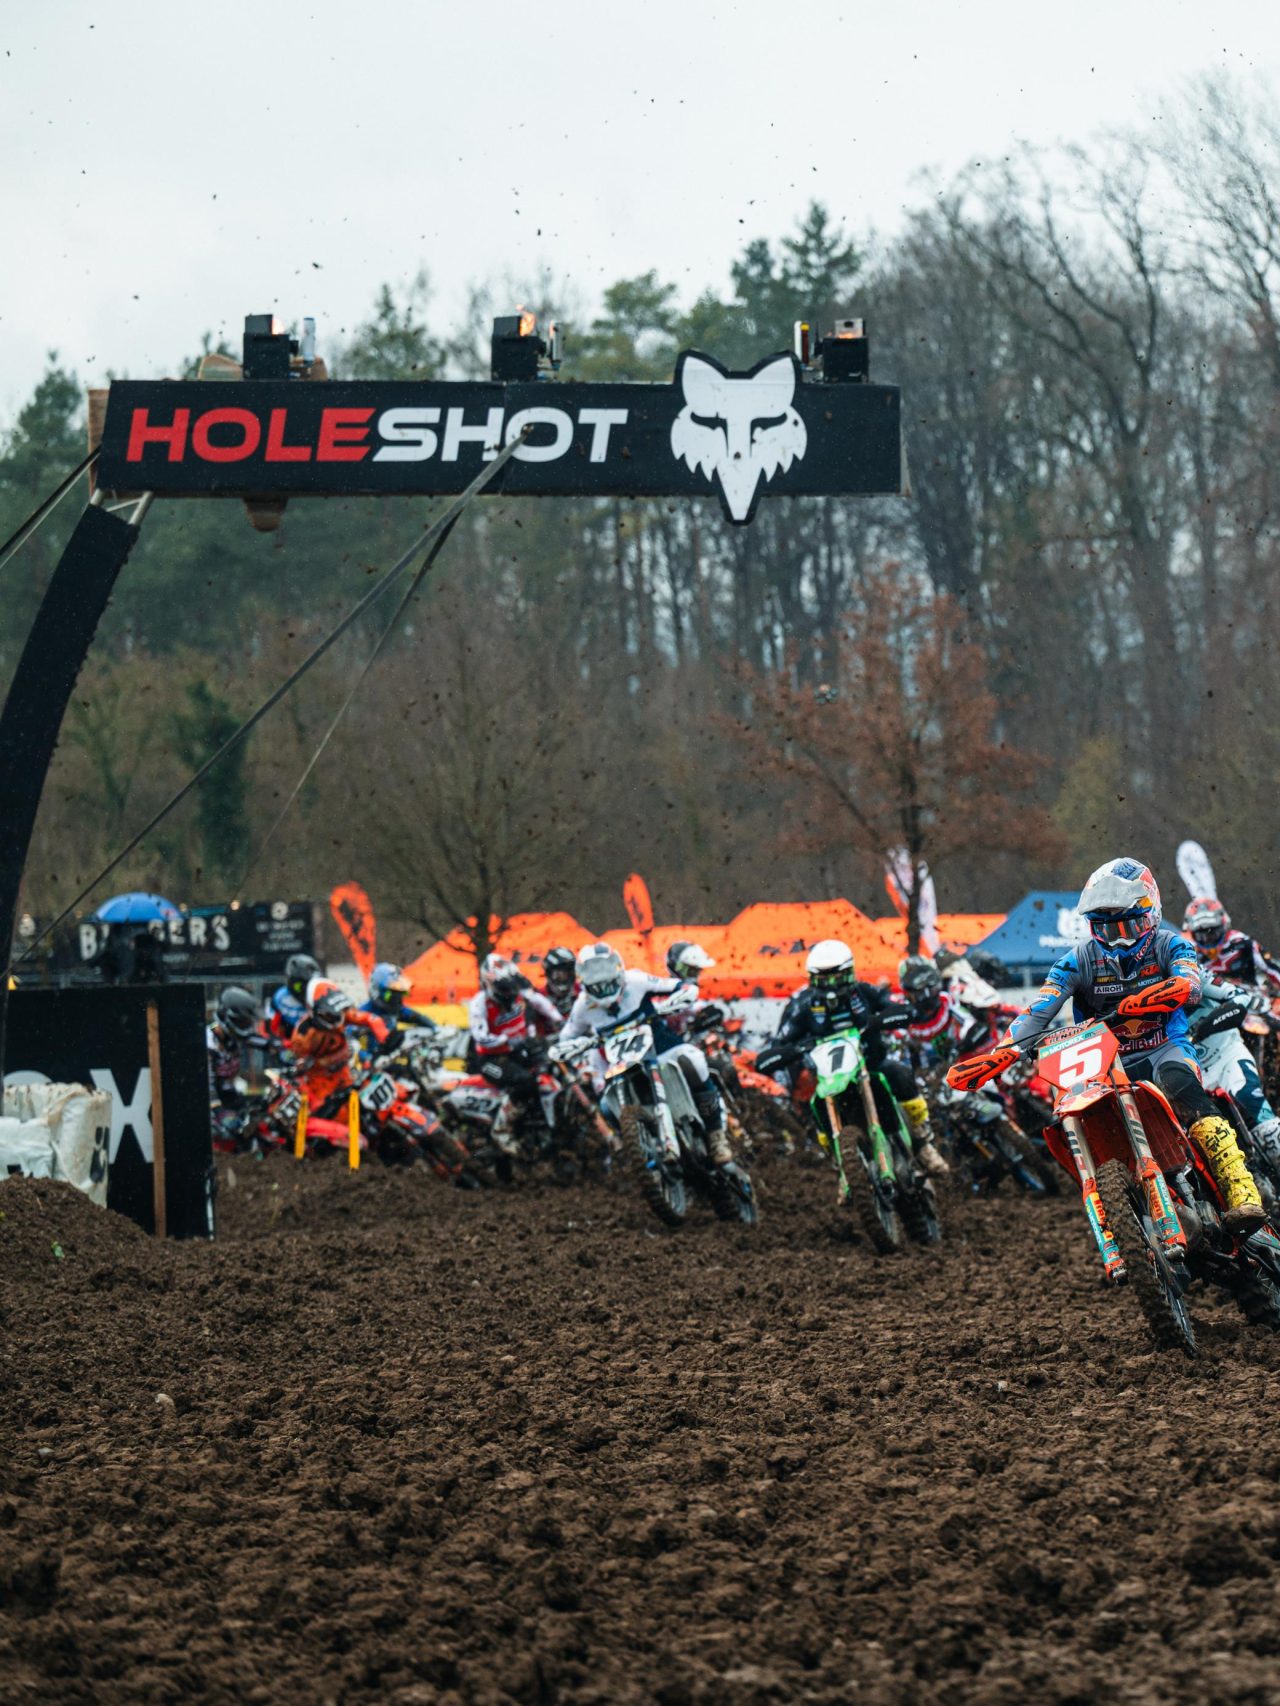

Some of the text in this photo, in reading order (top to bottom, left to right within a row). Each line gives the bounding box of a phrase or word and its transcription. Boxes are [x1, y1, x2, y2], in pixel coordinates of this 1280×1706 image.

[125, 406, 628, 463] HOLESHOT
[1095, 985, 1122, 994] AIROH
[1212, 1008, 1241, 1026] ACERBIS
[611, 1033, 645, 1060] 74
[827, 1046, 846, 1072] 1
[1059, 1034, 1103, 1091] 5
[369, 1078, 395, 1109] 101
